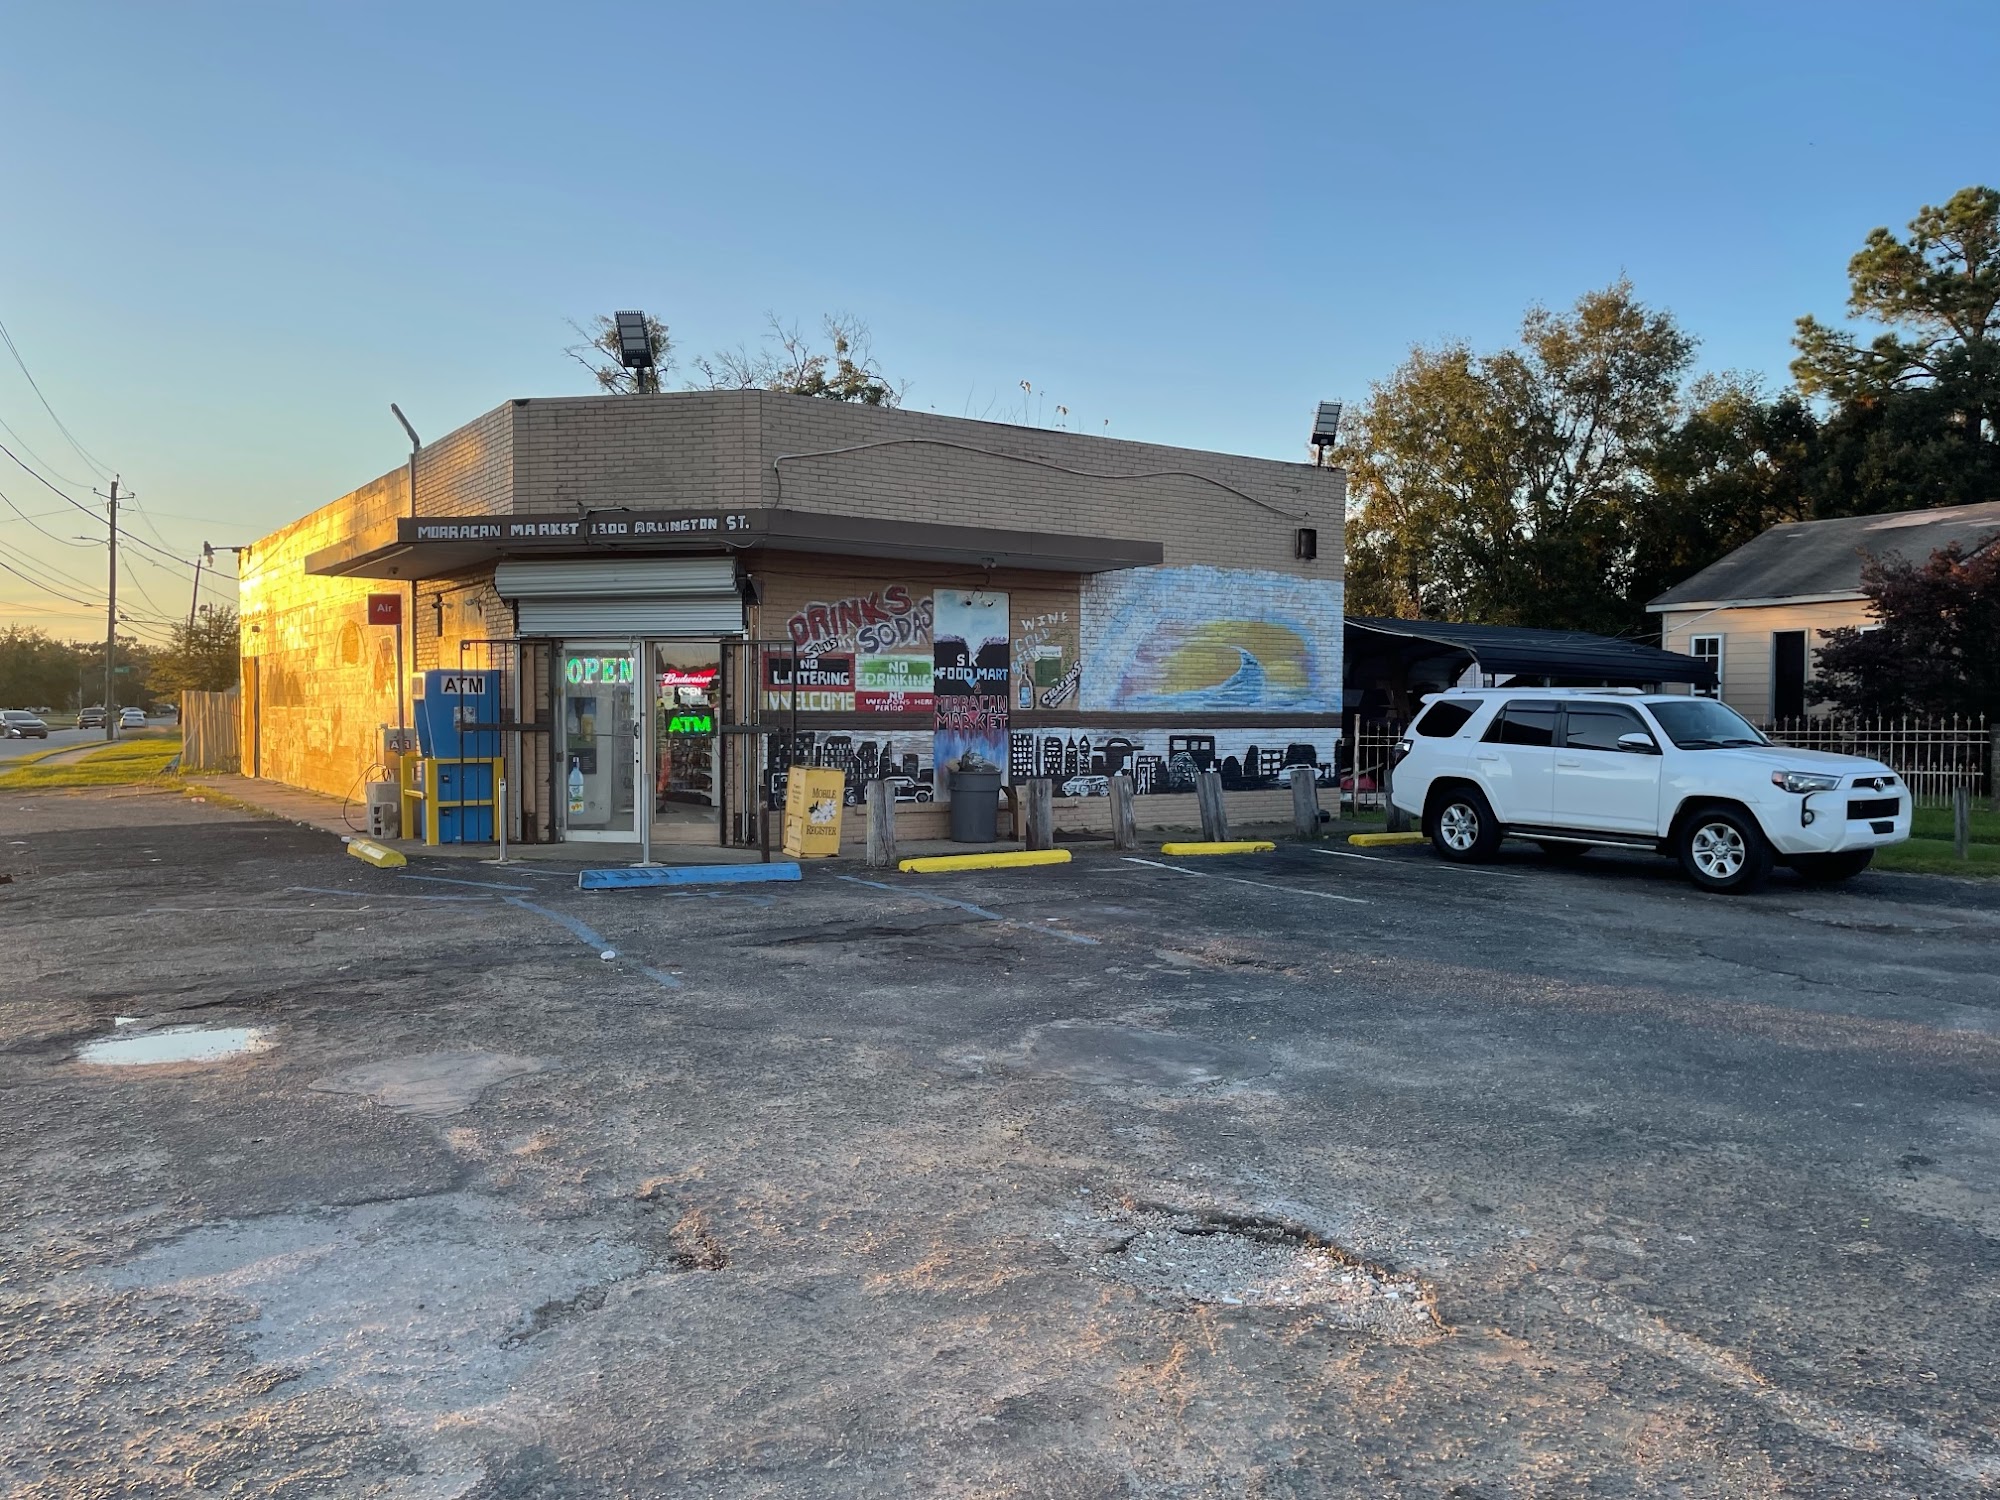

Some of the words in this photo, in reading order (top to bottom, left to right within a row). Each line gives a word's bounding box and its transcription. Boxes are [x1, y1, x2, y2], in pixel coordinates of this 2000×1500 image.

[510, 523, 580, 537] MARKET
[590, 523, 628, 535] 1300
[634, 518, 718, 533] ARLINGTON
[726, 515, 750, 531] ST.
[377, 603, 393, 612] Air
[788, 585, 913, 647] DRINKS
[1021, 612, 1069, 631] WINE
[857, 596, 934, 654] SODAS
[1014, 628, 1050, 653] COLD
[566, 657, 635, 684] OPEN
[800, 659, 819, 670] NO
[888, 661, 909, 673] NO
[662, 672, 712, 684] Budweiser
[864, 672, 932, 687] DRINKING
[938, 667, 973, 680] FOOD
[976, 668, 1009, 681] MART
[445, 677, 483, 693] ATM
[768, 691, 856, 711] WELCOME
[866, 698, 911, 706] WEAPONS
[889, 692, 905, 701] NO
[668, 716, 712, 732] ATM
[934, 712, 1009, 731] MARKET
[390, 740, 410, 749] AR
[812, 787, 837, 799] MOBILE
[806, 825, 837, 836] REGISTER
